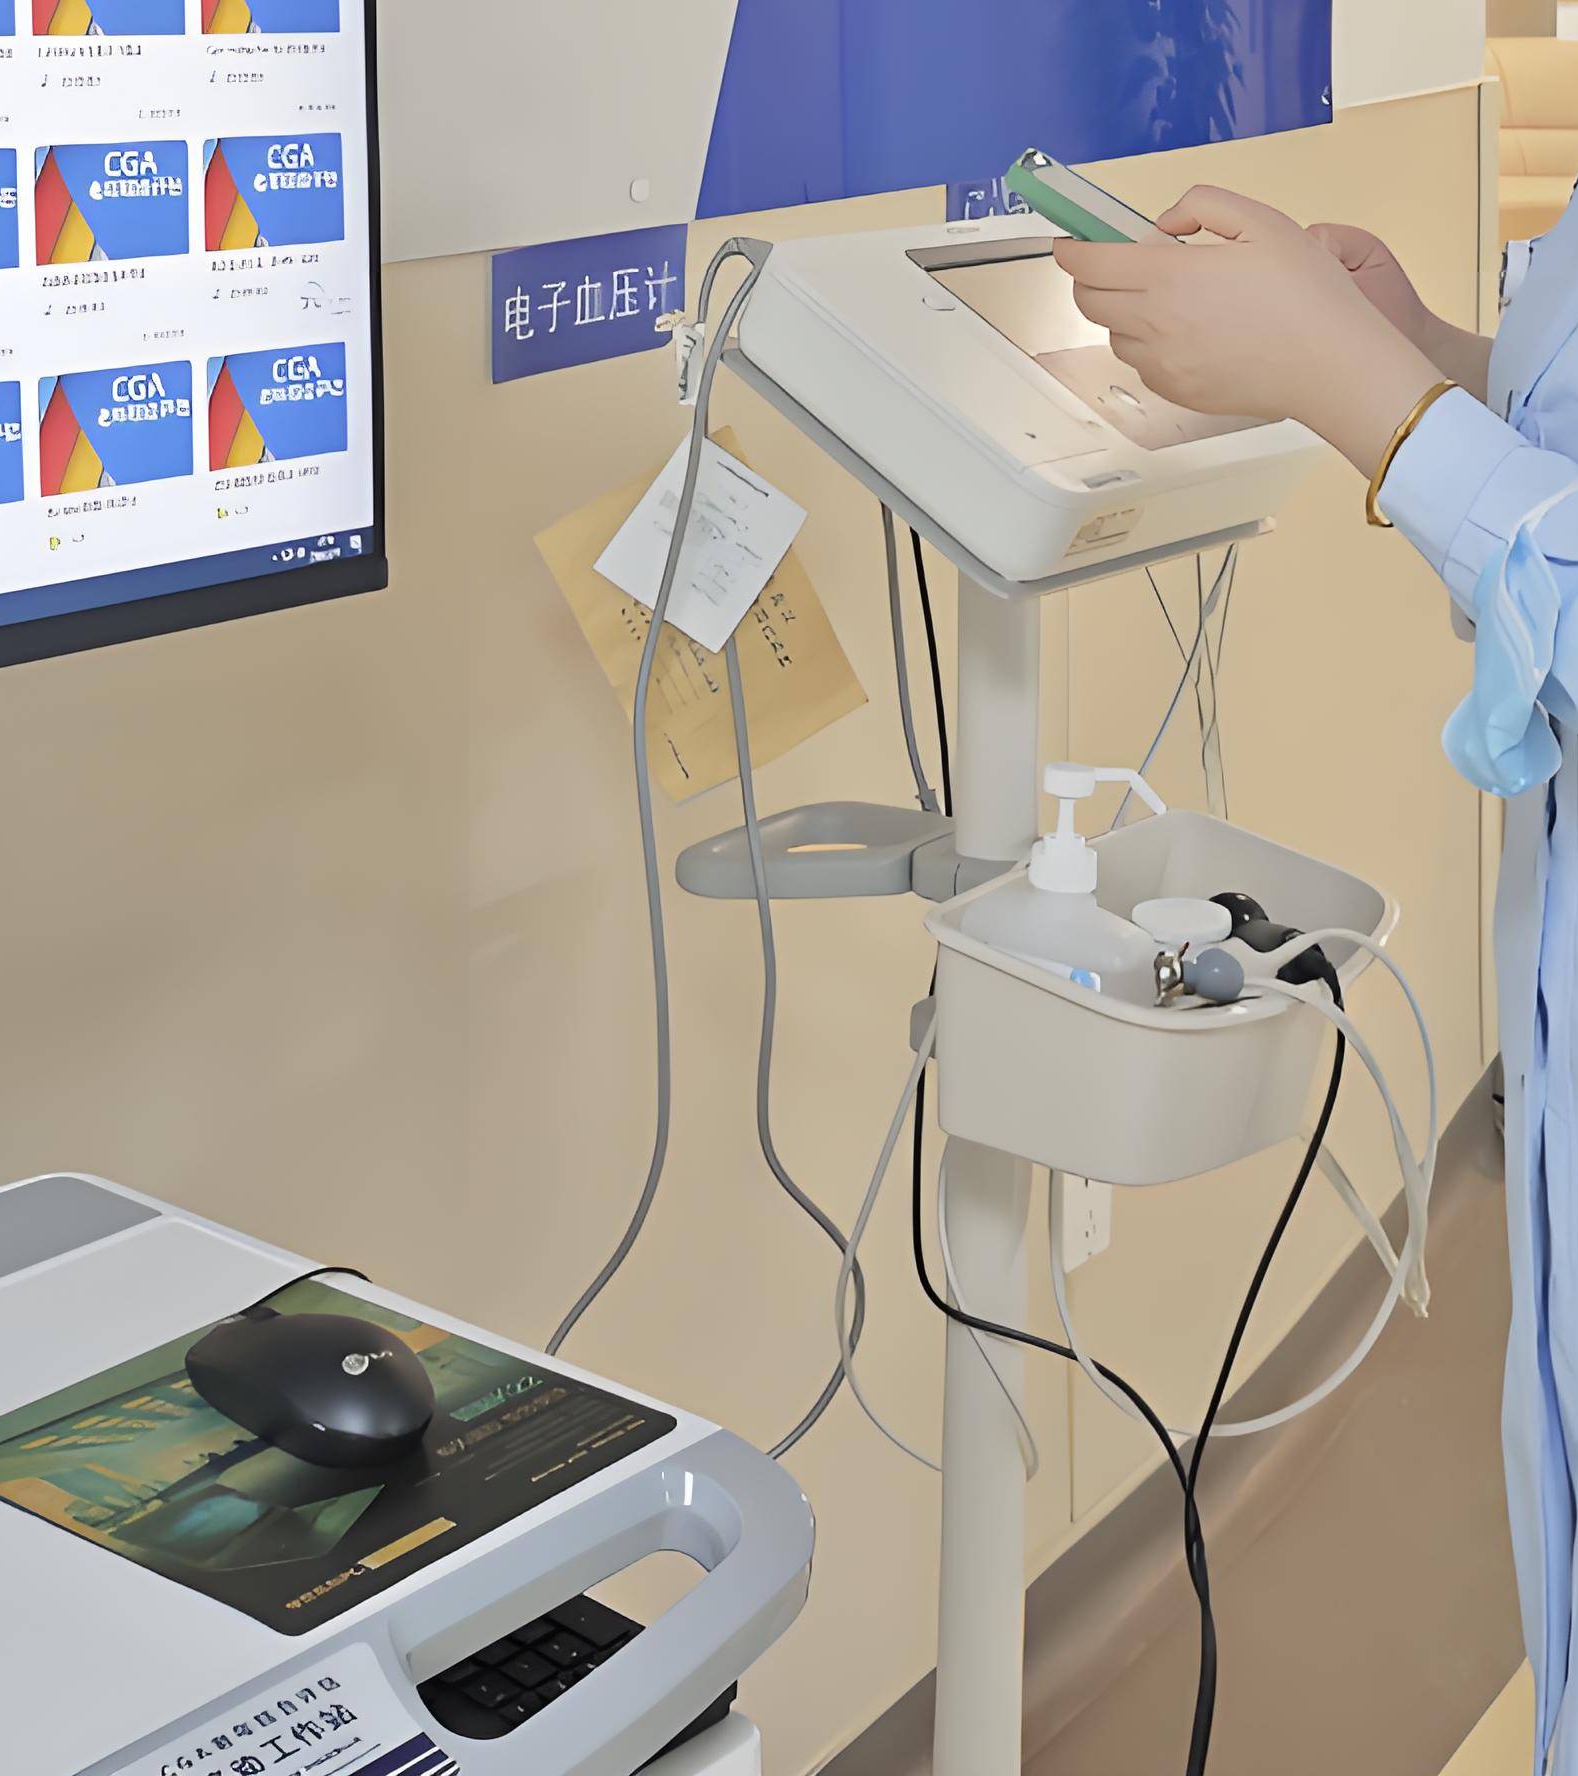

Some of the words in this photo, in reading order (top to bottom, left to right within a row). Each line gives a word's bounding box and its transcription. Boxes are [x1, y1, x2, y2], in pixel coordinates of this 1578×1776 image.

[505, 261, 678, 341] 电子血压计
